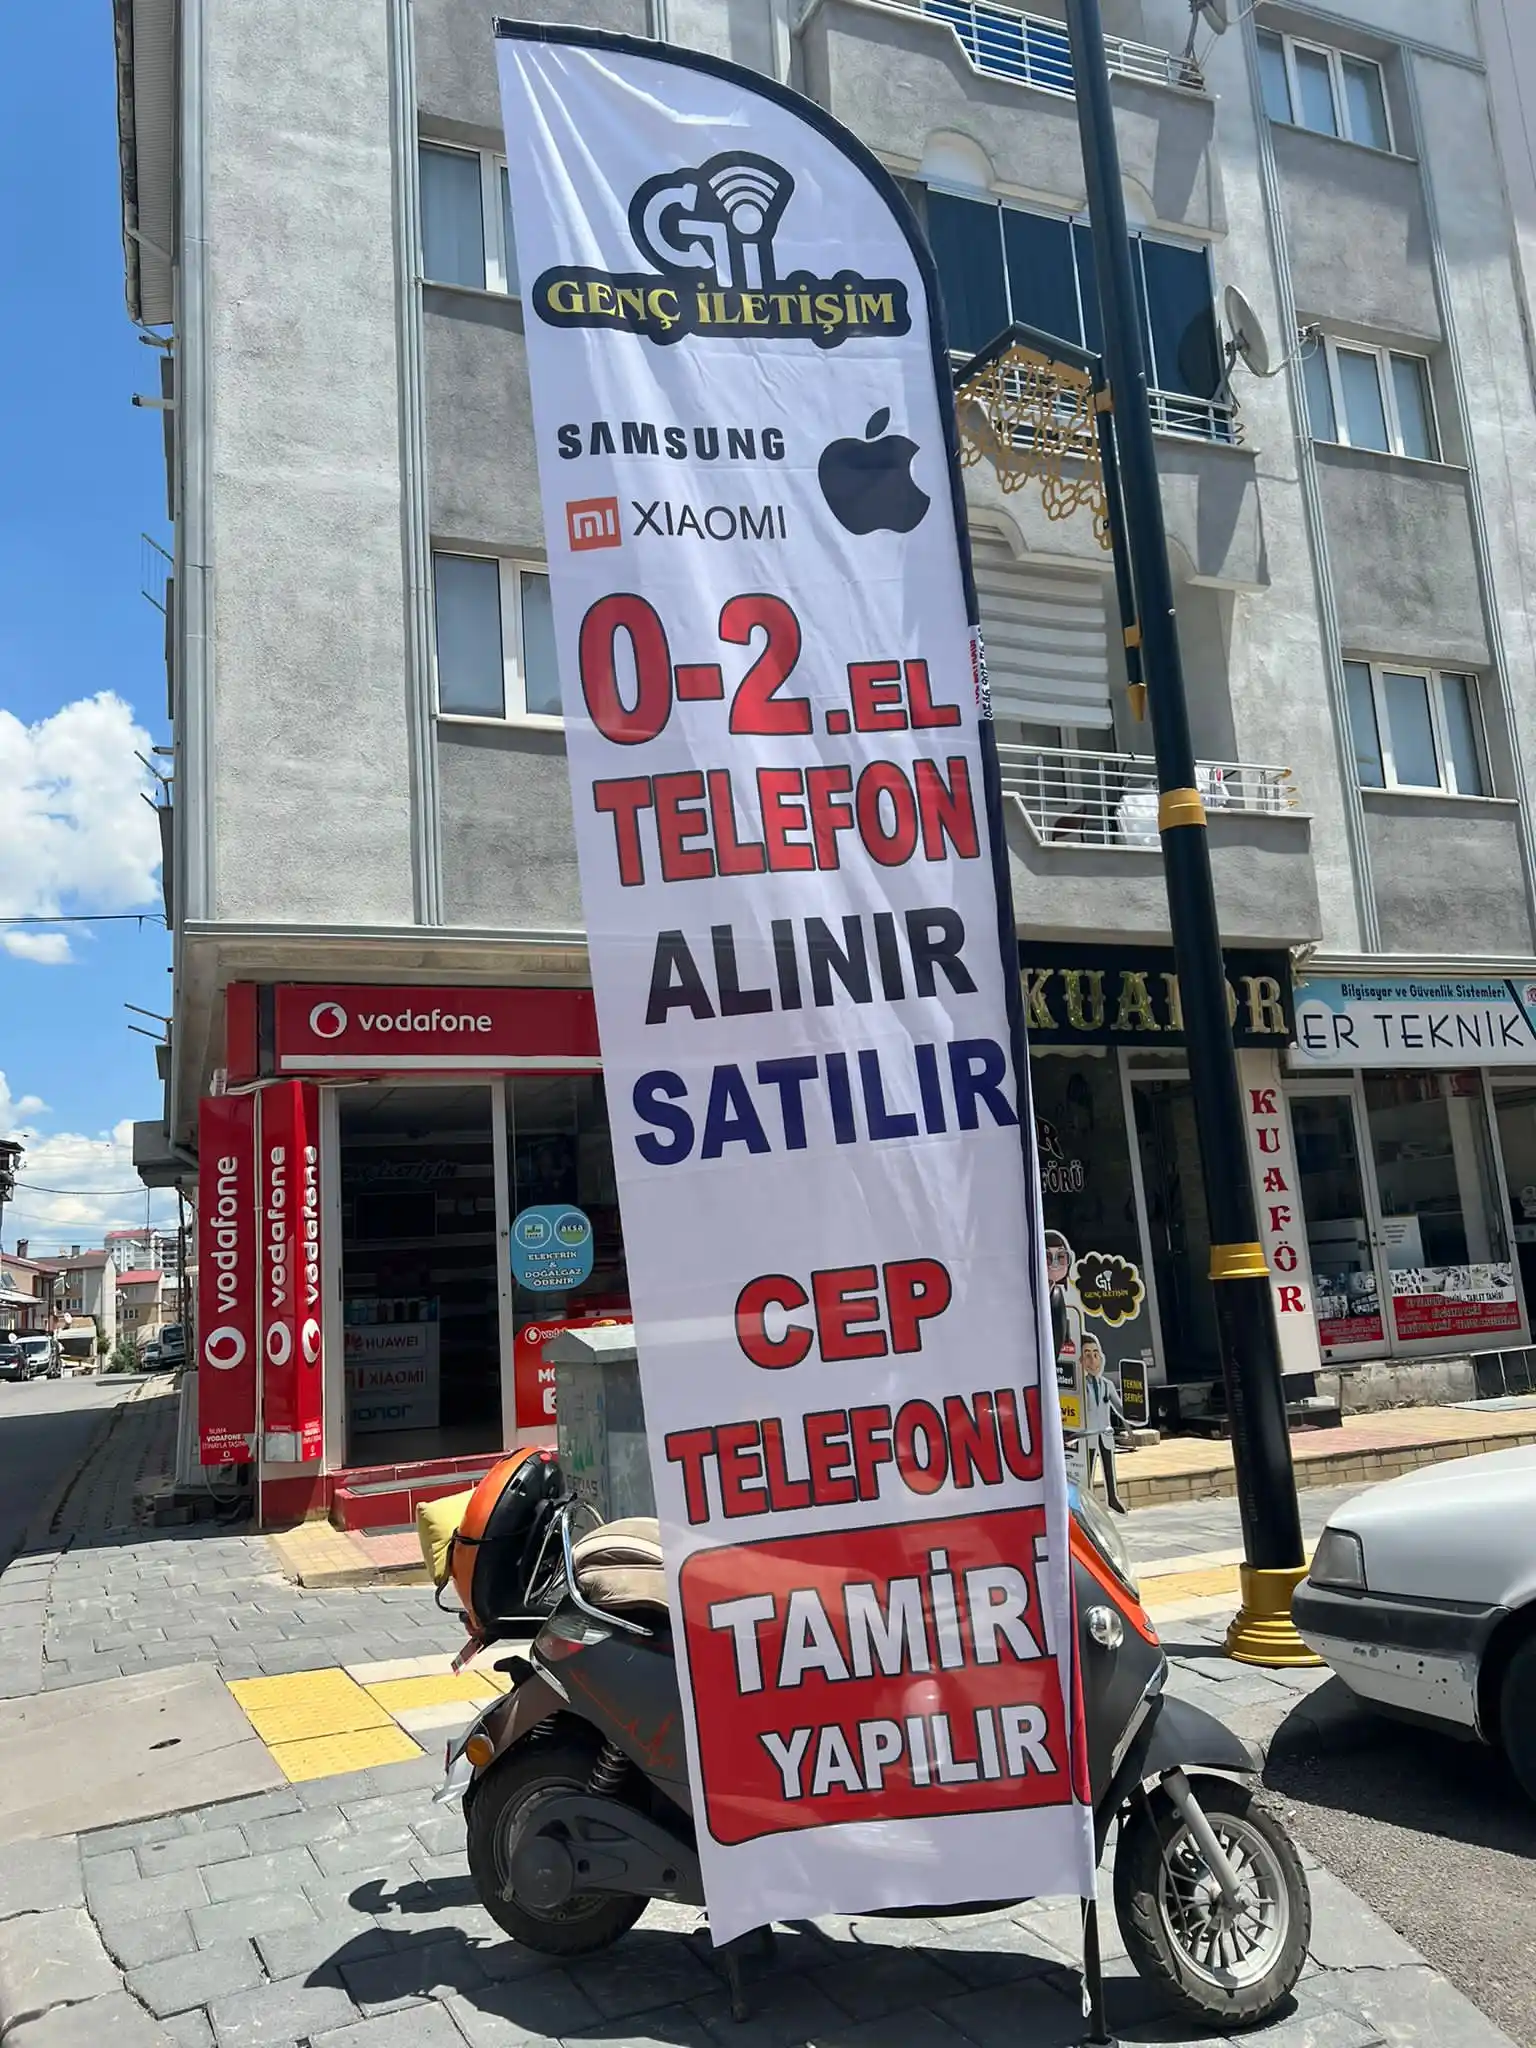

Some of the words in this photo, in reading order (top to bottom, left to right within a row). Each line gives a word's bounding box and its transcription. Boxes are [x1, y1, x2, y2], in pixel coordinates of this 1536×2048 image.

[547, 280, 682, 330] GENÇ
[695, 282, 897, 334] İLETİŞİM
[557, 421, 786, 461] SAMSUNG
[631, 500, 787, 541] XIAOMI
[592, 755, 981, 887] TELEFON
[645, 906, 979, 1026] ALINIR
[1341, 983, 1392, 1000] Bilgisayar
[1396, 988, 1407, 998] ve
[1410, 984, 1453, 998] Güvenlik
[1456, 984, 1506, 998] Sistemleri
[358, 1008, 493, 1032] vodafone
[1303, 1014, 1360, 1048] ER
[1373, 1010, 1524, 1048] TEKNİK
[632, 1037, 1021, 1167] SATILIR
[210, 1155, 238, 1314] vodafone
[268, 1146, 287, 1308] vodafone
[302, 1145, 319, 1306] vodafone
[1249, 1088, 1307, 1313] KUAFÖR
[525, 1267, 582, 1279] DOĞALGAZ
[527, 1250, 577, 1261] ELEKTRİK
[365, 1336, 419, 1350] HUAWEI
[734, 1257, 953, 1370] CEP
[369, 1369, 425, 1386] XIAOMI
[664, 1382, 1046, 1526] TELEFONU
[760, 1704, 1060, 1800] YAPILIR
